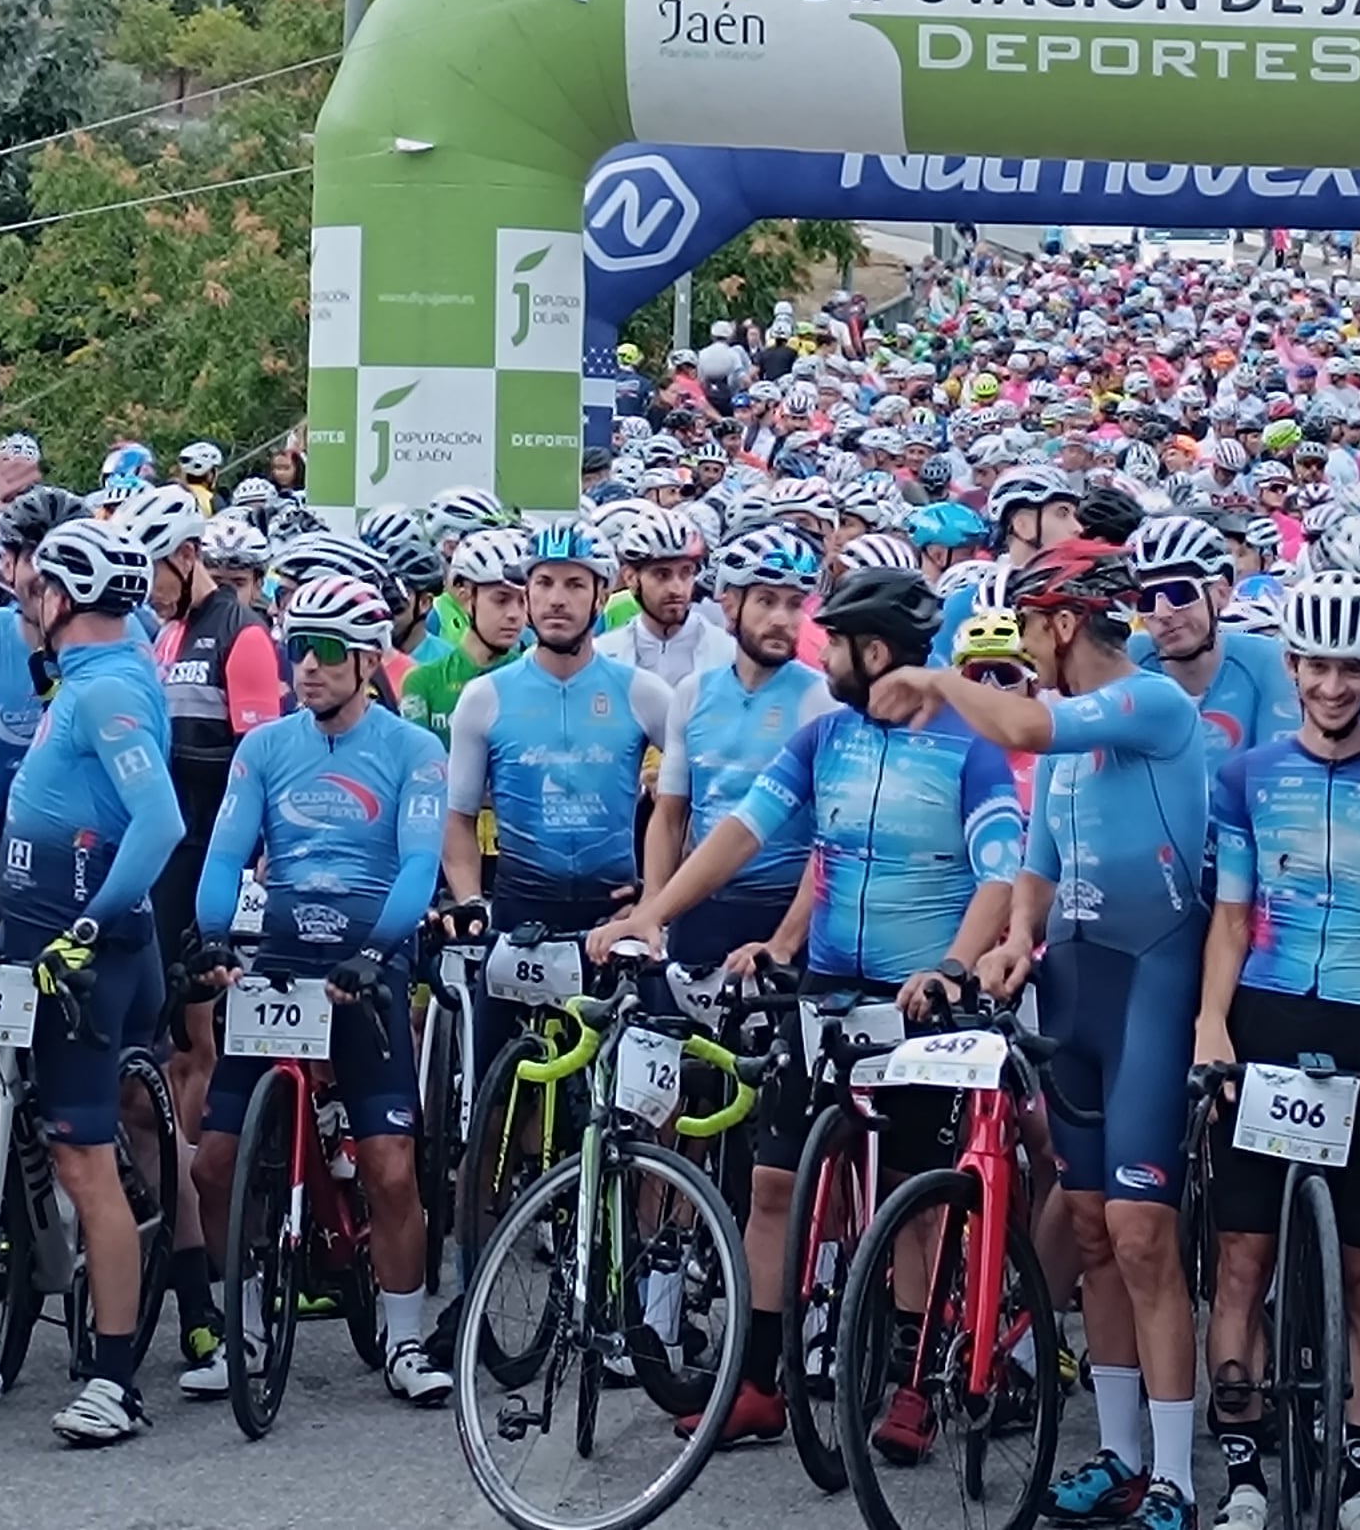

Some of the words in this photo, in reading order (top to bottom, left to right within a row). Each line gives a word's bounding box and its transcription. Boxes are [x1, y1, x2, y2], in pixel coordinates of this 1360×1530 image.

[393, 431, 483, 446] DIPUTACIÓN
[394, 448, 413, 462] DE
[514, 960, 545, 984] 85
[254, 1003, 302, 1027] 170
[923, 1035, 978, 1055] 649
[1269, 1094, 1327, 1129] 506
